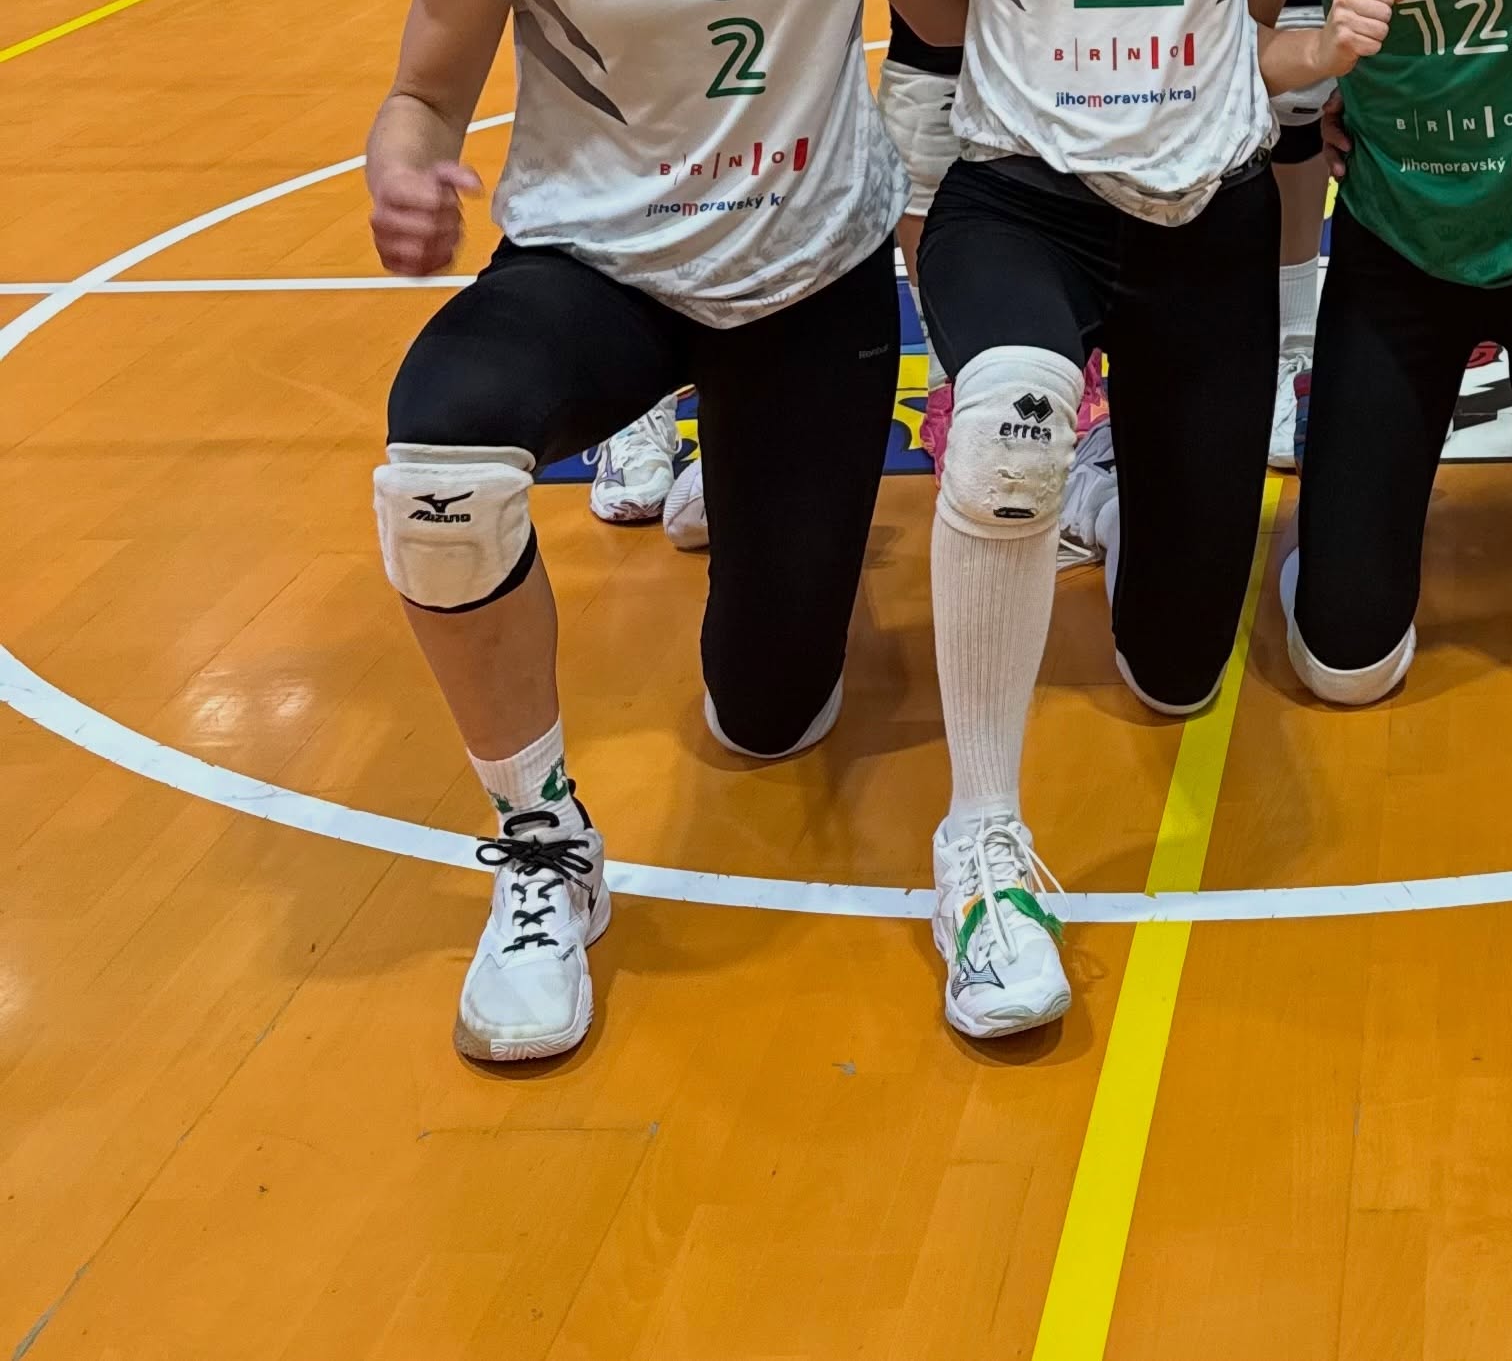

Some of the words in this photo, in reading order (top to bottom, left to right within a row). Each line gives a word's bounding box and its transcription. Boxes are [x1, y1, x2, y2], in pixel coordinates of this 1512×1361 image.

[706, 16, 767, 98] 2
[1055, 90, 1168, 108] jihomoravský
[1169, 85, 1197, 102] kraj
[1400, 155, 1506, 175] jihomoravský
